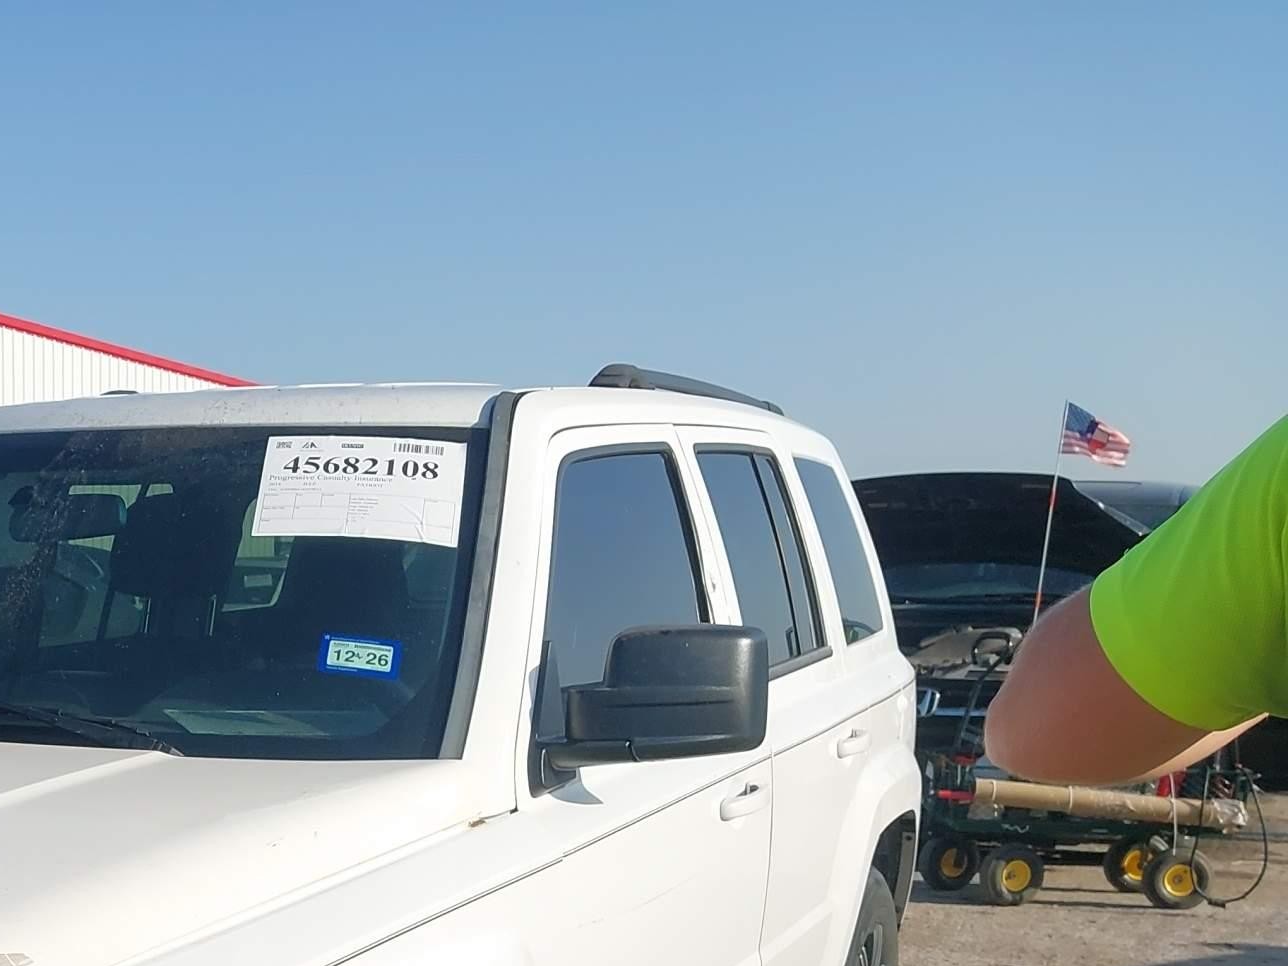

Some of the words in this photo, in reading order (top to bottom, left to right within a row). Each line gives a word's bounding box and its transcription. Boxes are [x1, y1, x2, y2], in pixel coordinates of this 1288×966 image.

[283, 455, 439, 480] 45682108
[268, 474, 315, 482] Progressive
[333, 648, 356, 663] 12
[365, 652, 389, 667] 26
